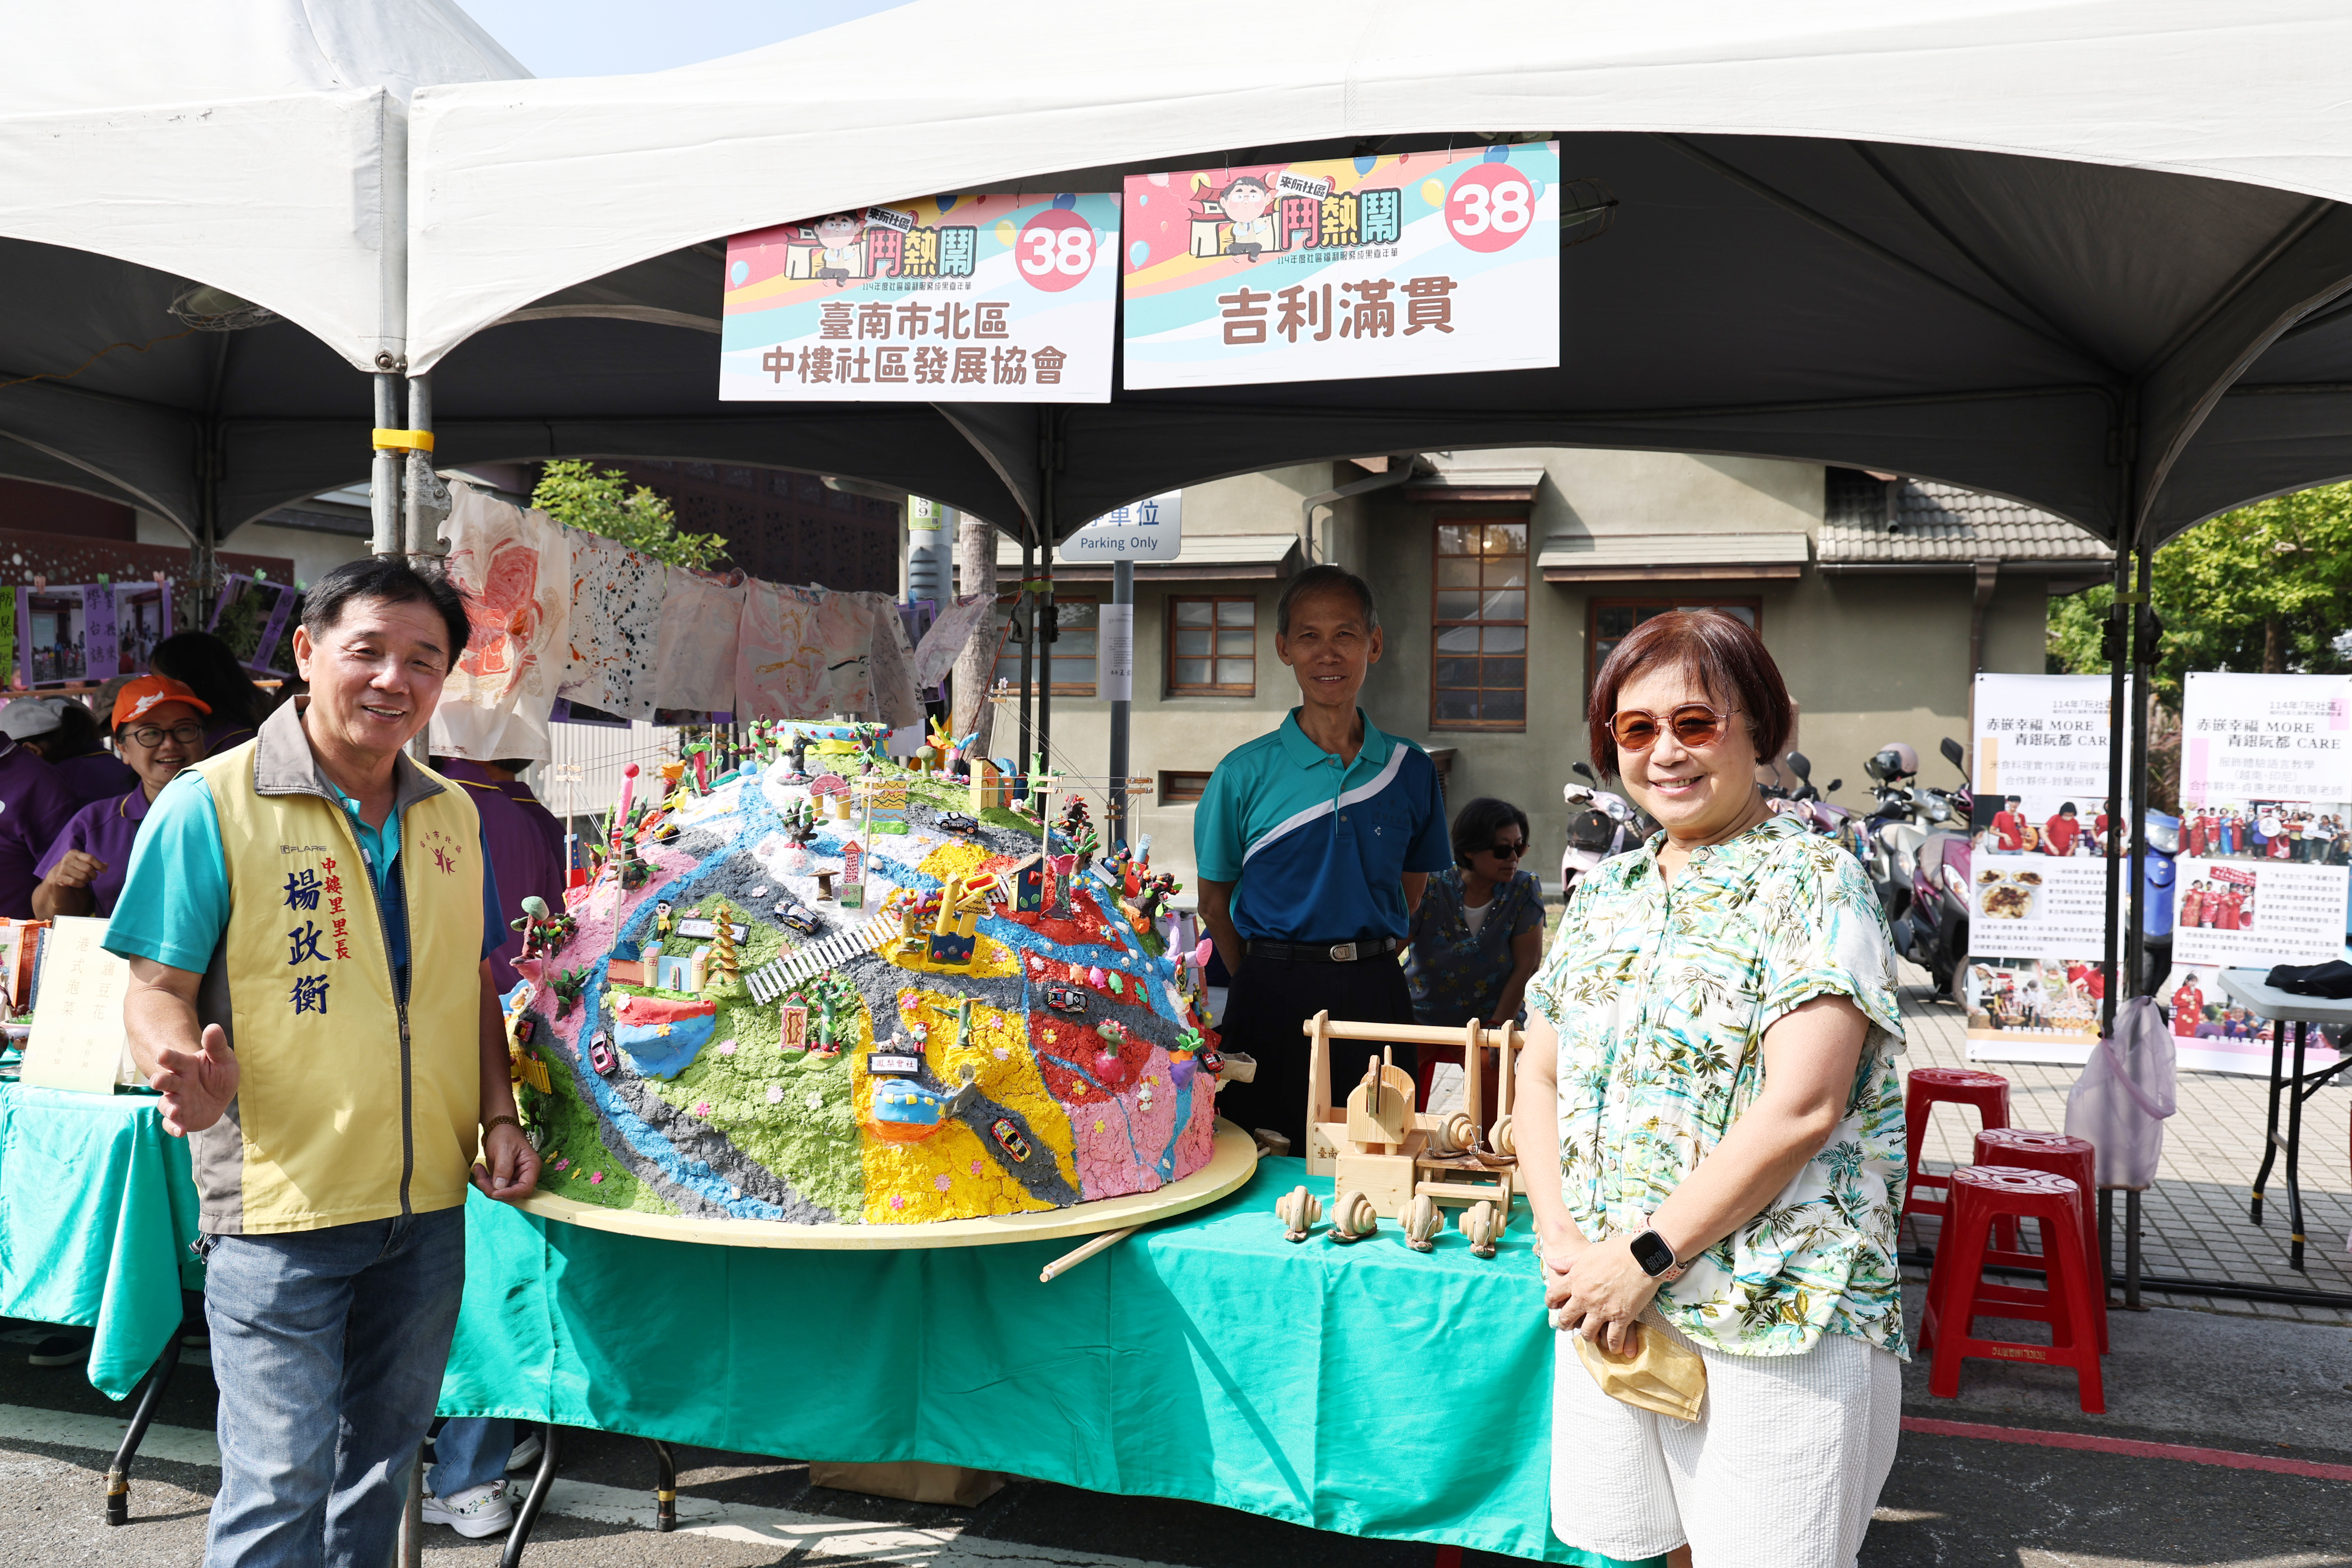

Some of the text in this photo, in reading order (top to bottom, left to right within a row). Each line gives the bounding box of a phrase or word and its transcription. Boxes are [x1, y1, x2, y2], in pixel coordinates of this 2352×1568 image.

[1279, 175, 1327, 197] 來阮社區
[868, 207, 910, 231] 來阮社區
[1452, 179, 1530, 236] 38
[1021, 227, 1091, 276] 38
[819, 302, 1010, 340] 臺南市北區
[1218, 276, 1458, 345] 吉利滿貫
[763, 345, 1067, 385] 中樓社區發展協會
[1091, 500, 1159, 527] 車位
[1081, 536, 1158, 551] Parking Only
[1987, 718, 2094, 731] 赤嵌幸福 MORE
[2197, 718, 2315, 733] 赤嵌幸福 MORE
[2016, 733, 2110, 746] 青銀阮都 CAR
[2227, 734, 2341, 749] 青銀阮都 CARE
[321, 858, 352, 960] 中樓里里長
[283, 868, 332, 1015] 楊政衡
[61, 936, 90, 1017] 港式泡菜
[92, 952, 116, 1020] 滷豆花
[877, 1059, 914, 1068] 鳳梨會社
[1318, 1146, 1340, 1159] 臺南
[1645, 1250, 1668, 1270] 10:09
